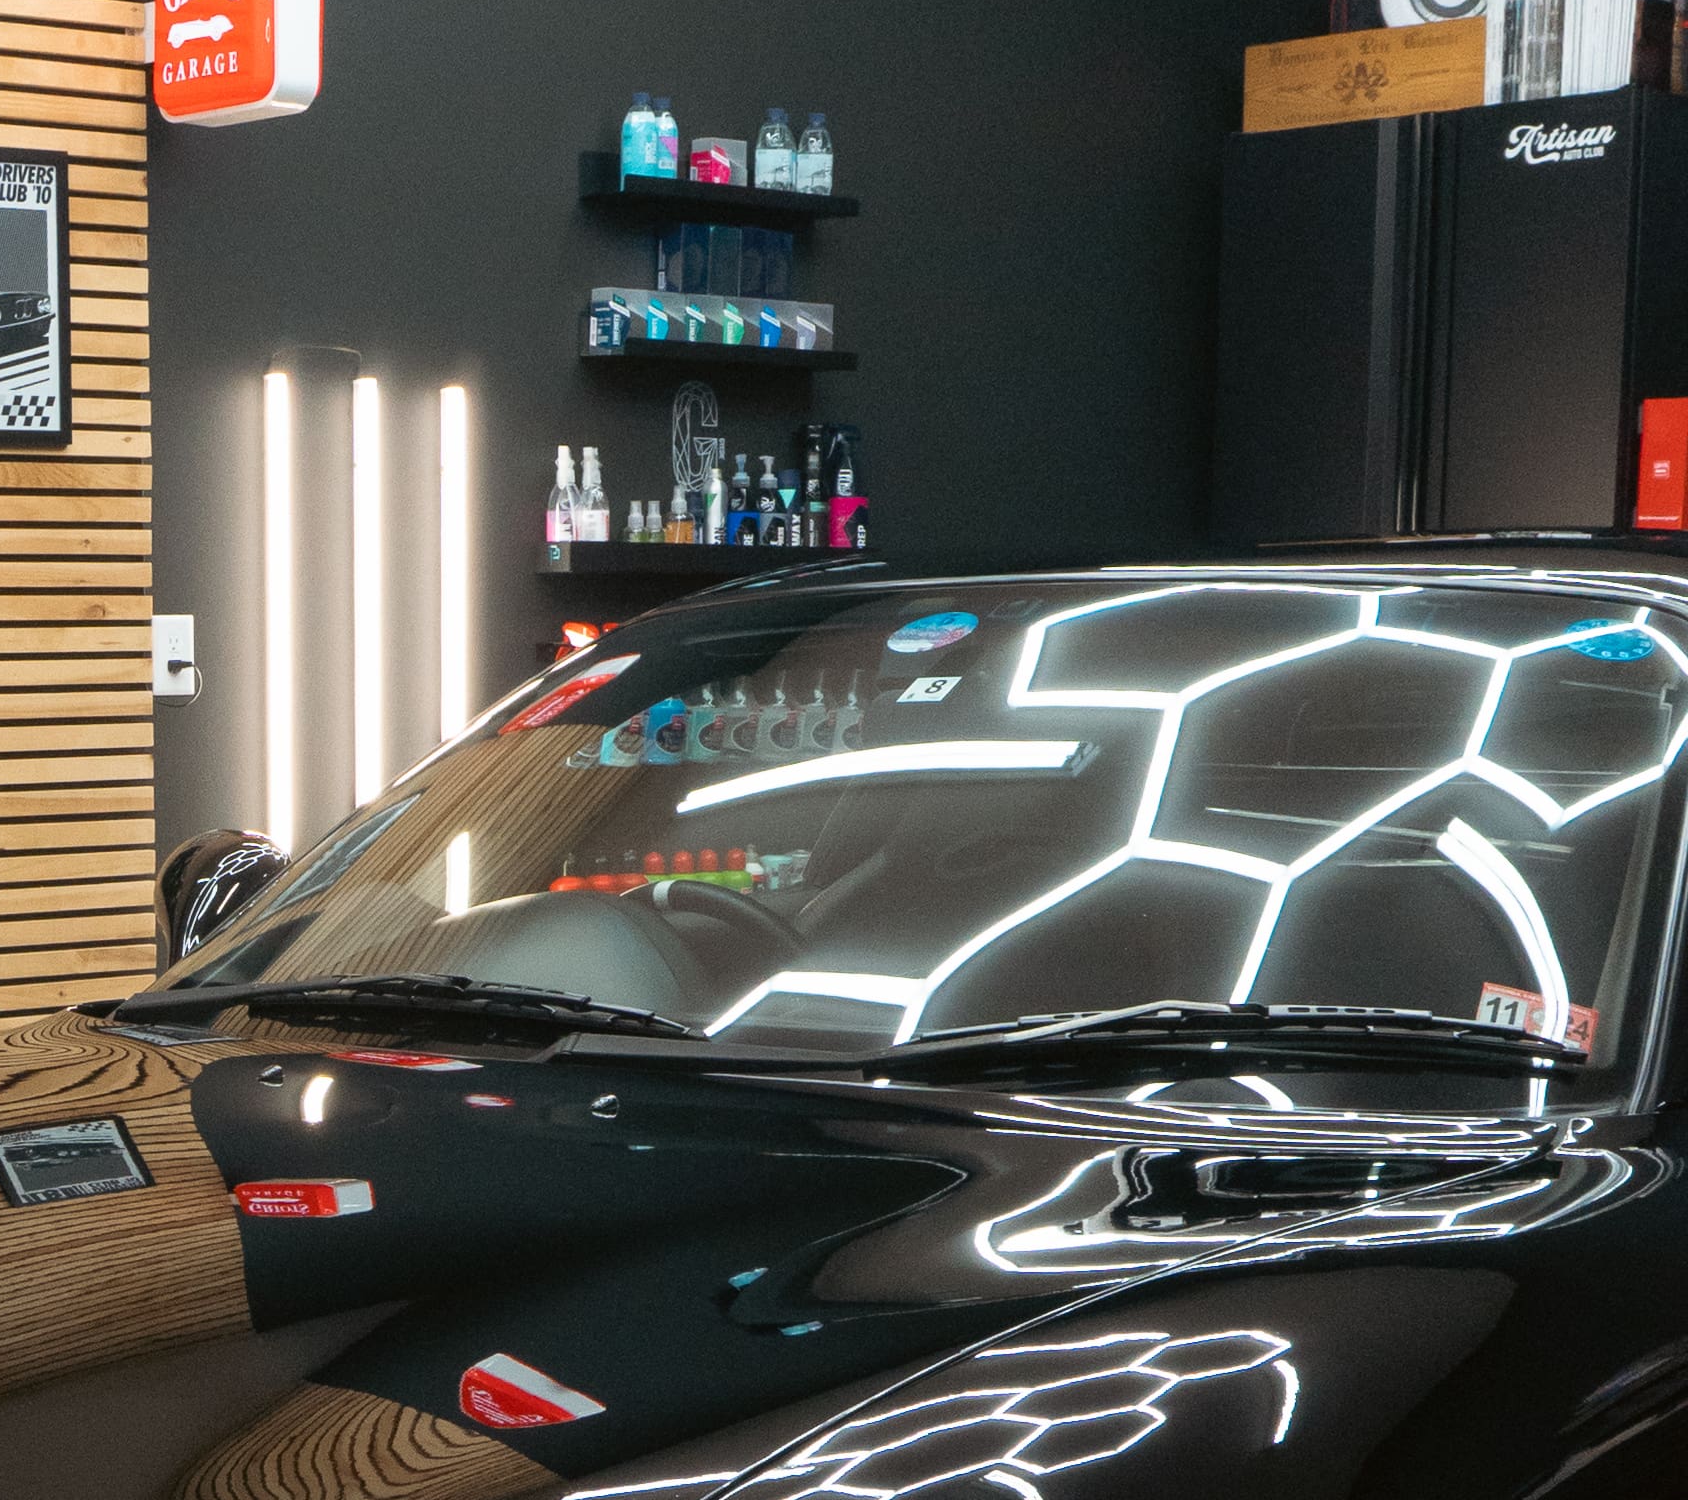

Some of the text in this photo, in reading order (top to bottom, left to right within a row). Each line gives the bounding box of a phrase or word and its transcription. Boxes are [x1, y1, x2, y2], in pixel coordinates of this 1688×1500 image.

[163, 51, 239, 85] GARAGE
[1504, 122, 1617, 164] Artisan
[857, 524, 866, 549] REP
[924, 679, 947, 694] 8
[1486, 996, 1520, 1026] 11
